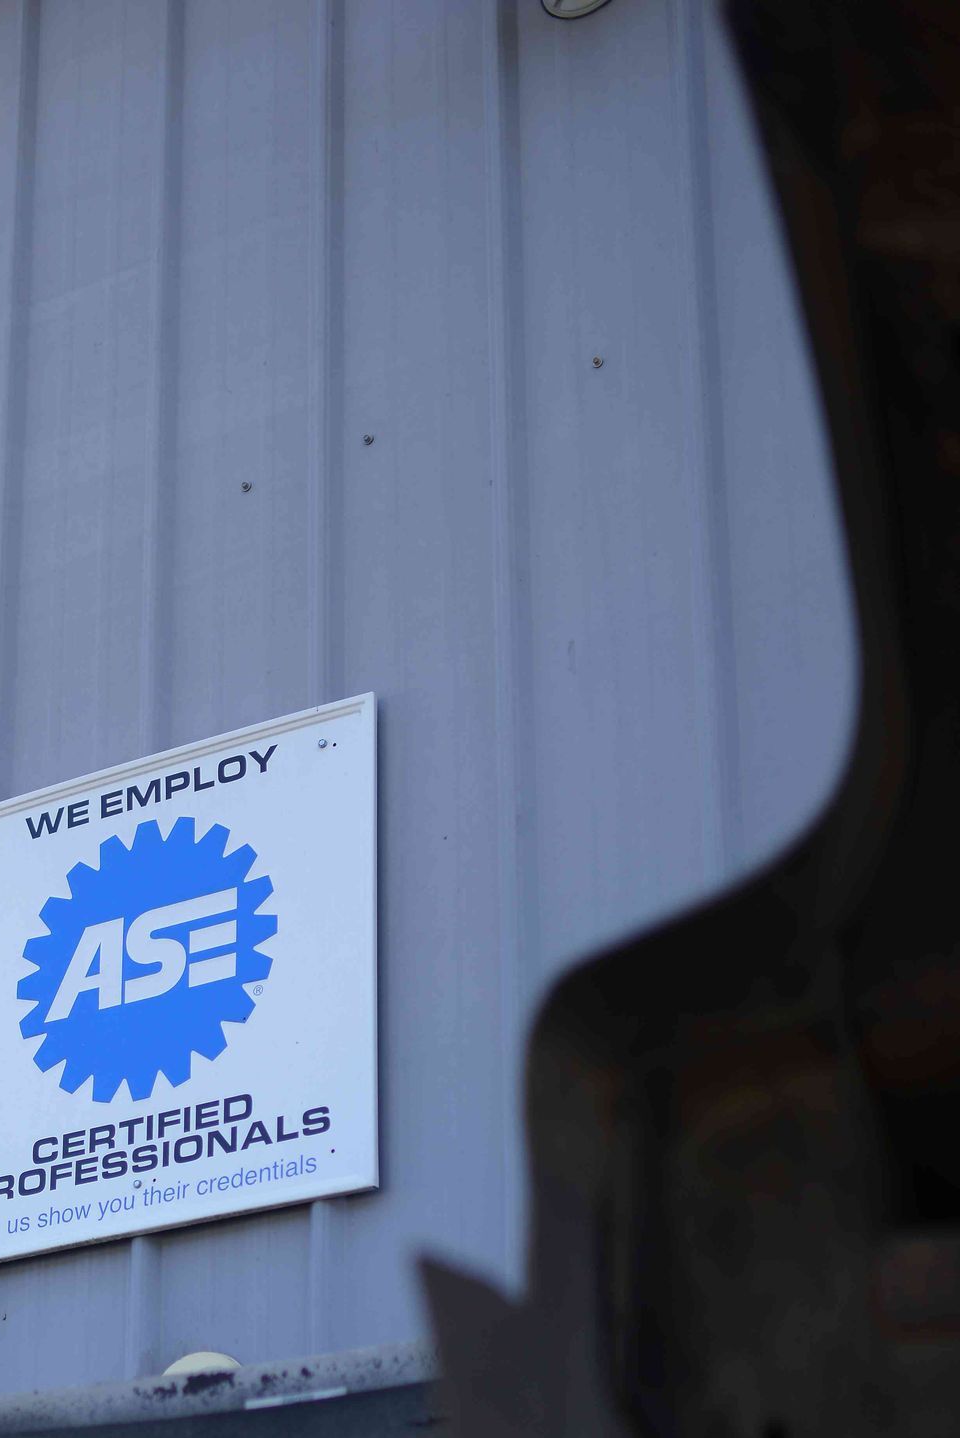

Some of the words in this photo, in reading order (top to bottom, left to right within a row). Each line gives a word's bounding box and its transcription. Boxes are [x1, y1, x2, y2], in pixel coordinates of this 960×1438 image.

[25, 799, 90, 840] WE
[100, 744, 278, 819] EMPLOY
[44, 886, 238, 1023] ASE
[32, 1093, 253, 1165] CERTIFIED
[7, 1215, 31, 1234] us
[37, 1206, 92, 1228] show
[98, 1194, 135, 1221] you
[143, 1180, 190, 1207] their
[196, 1154, 317, 1196] credentials
